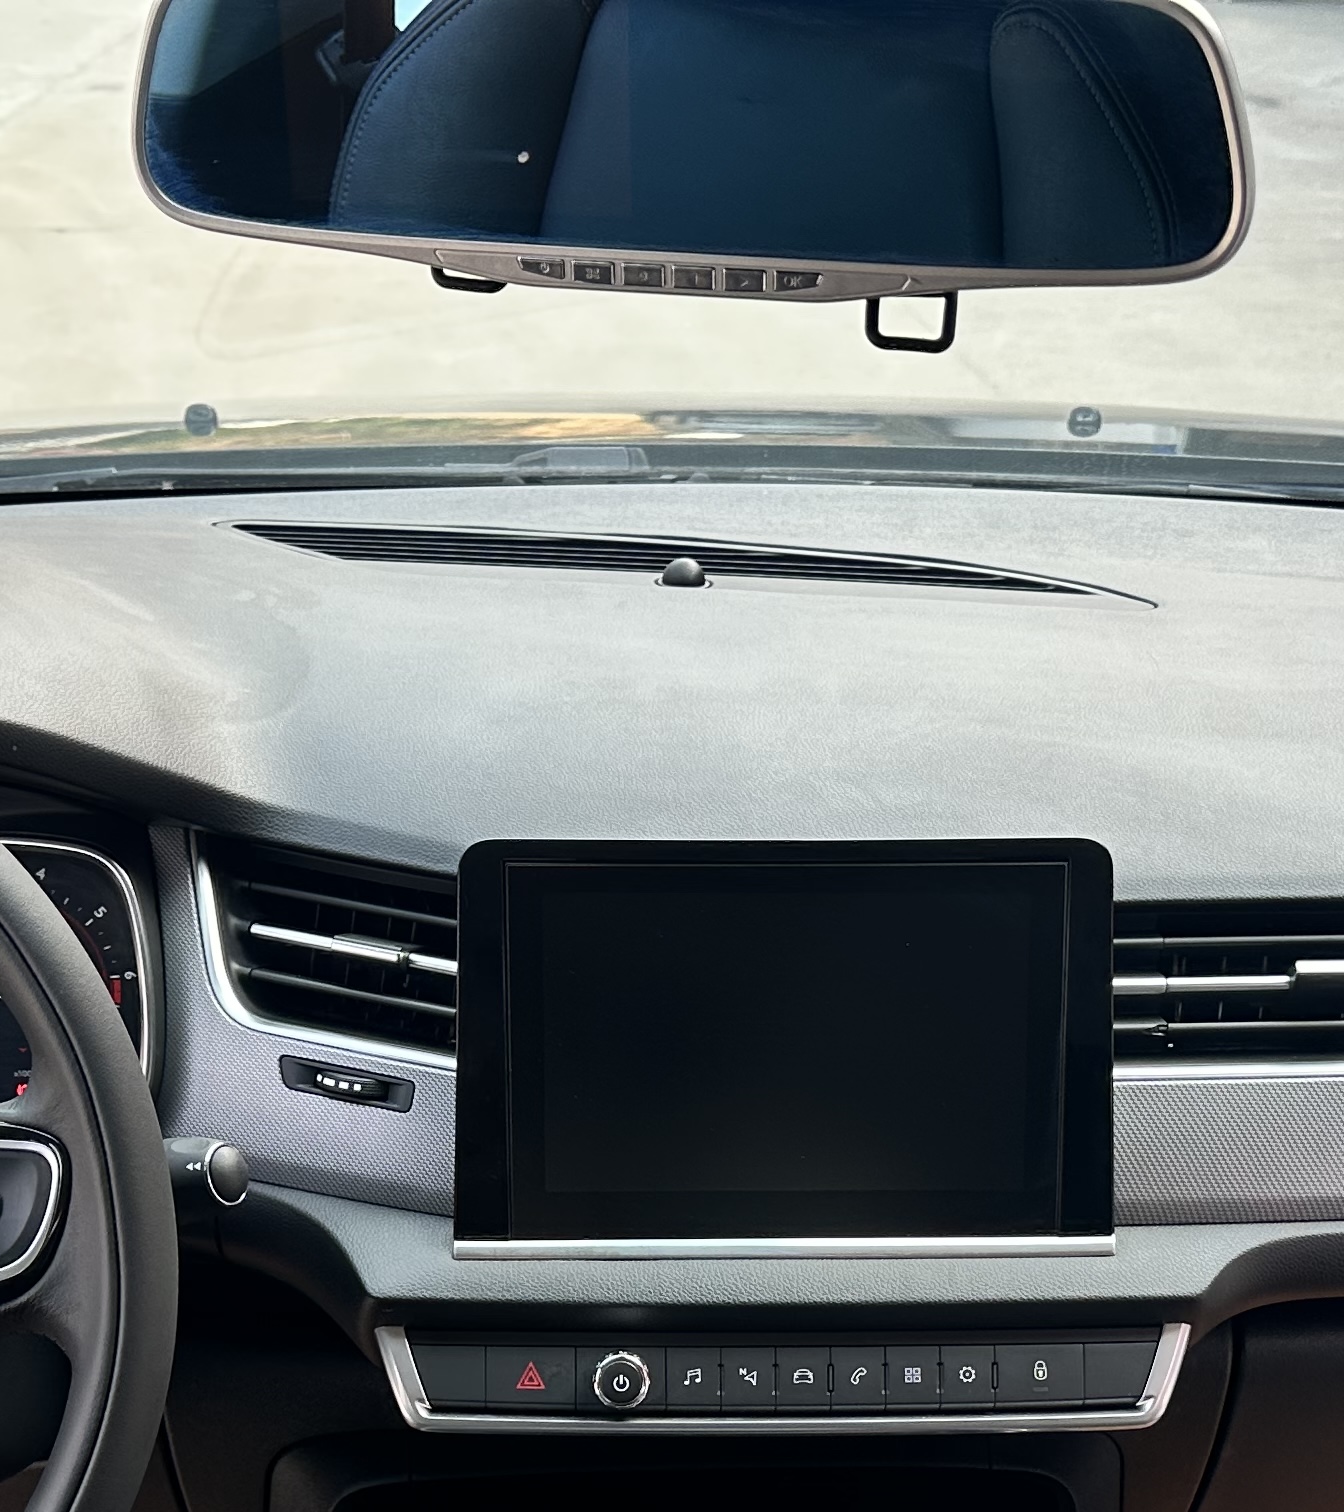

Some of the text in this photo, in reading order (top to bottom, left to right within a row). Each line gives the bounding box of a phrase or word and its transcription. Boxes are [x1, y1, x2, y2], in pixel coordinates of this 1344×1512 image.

[783, 275, 803, 288] OK
[35, 867, 46, 881] 4
[93, 905, 108, 918] 5
[124, 970, 138, 980] 6
